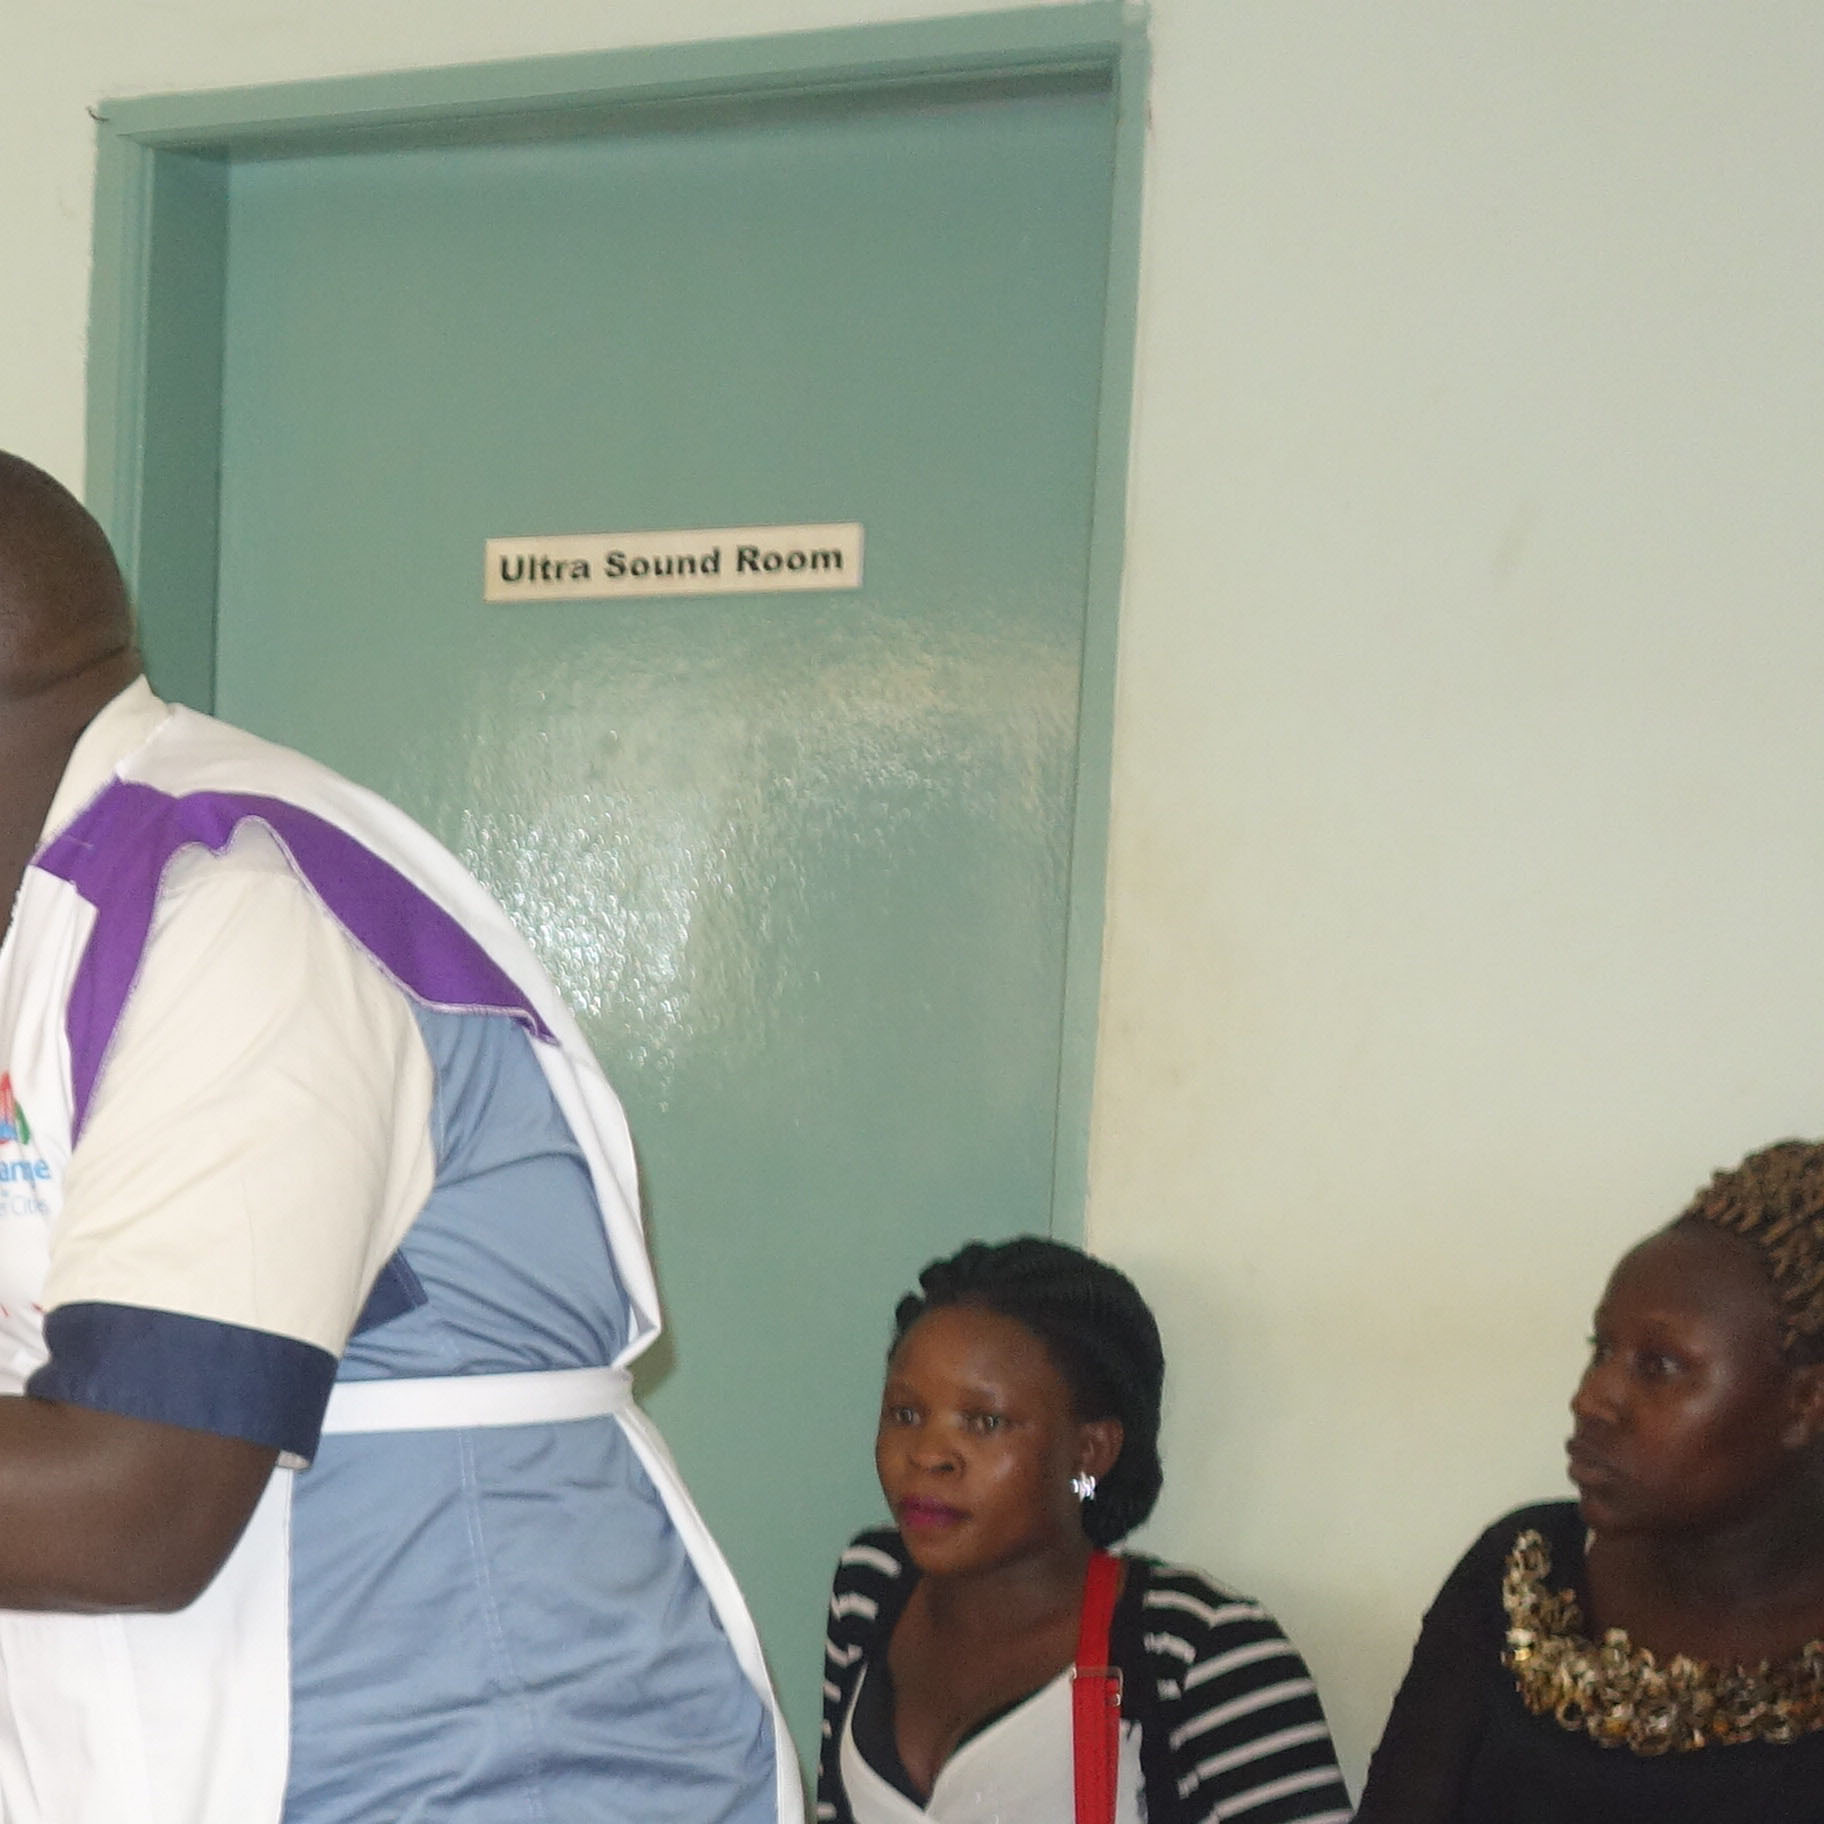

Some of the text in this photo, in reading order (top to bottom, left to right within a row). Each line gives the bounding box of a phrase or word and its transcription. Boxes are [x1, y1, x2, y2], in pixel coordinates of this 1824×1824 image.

[499, 543, 844, 583] Ultra Sound Room
